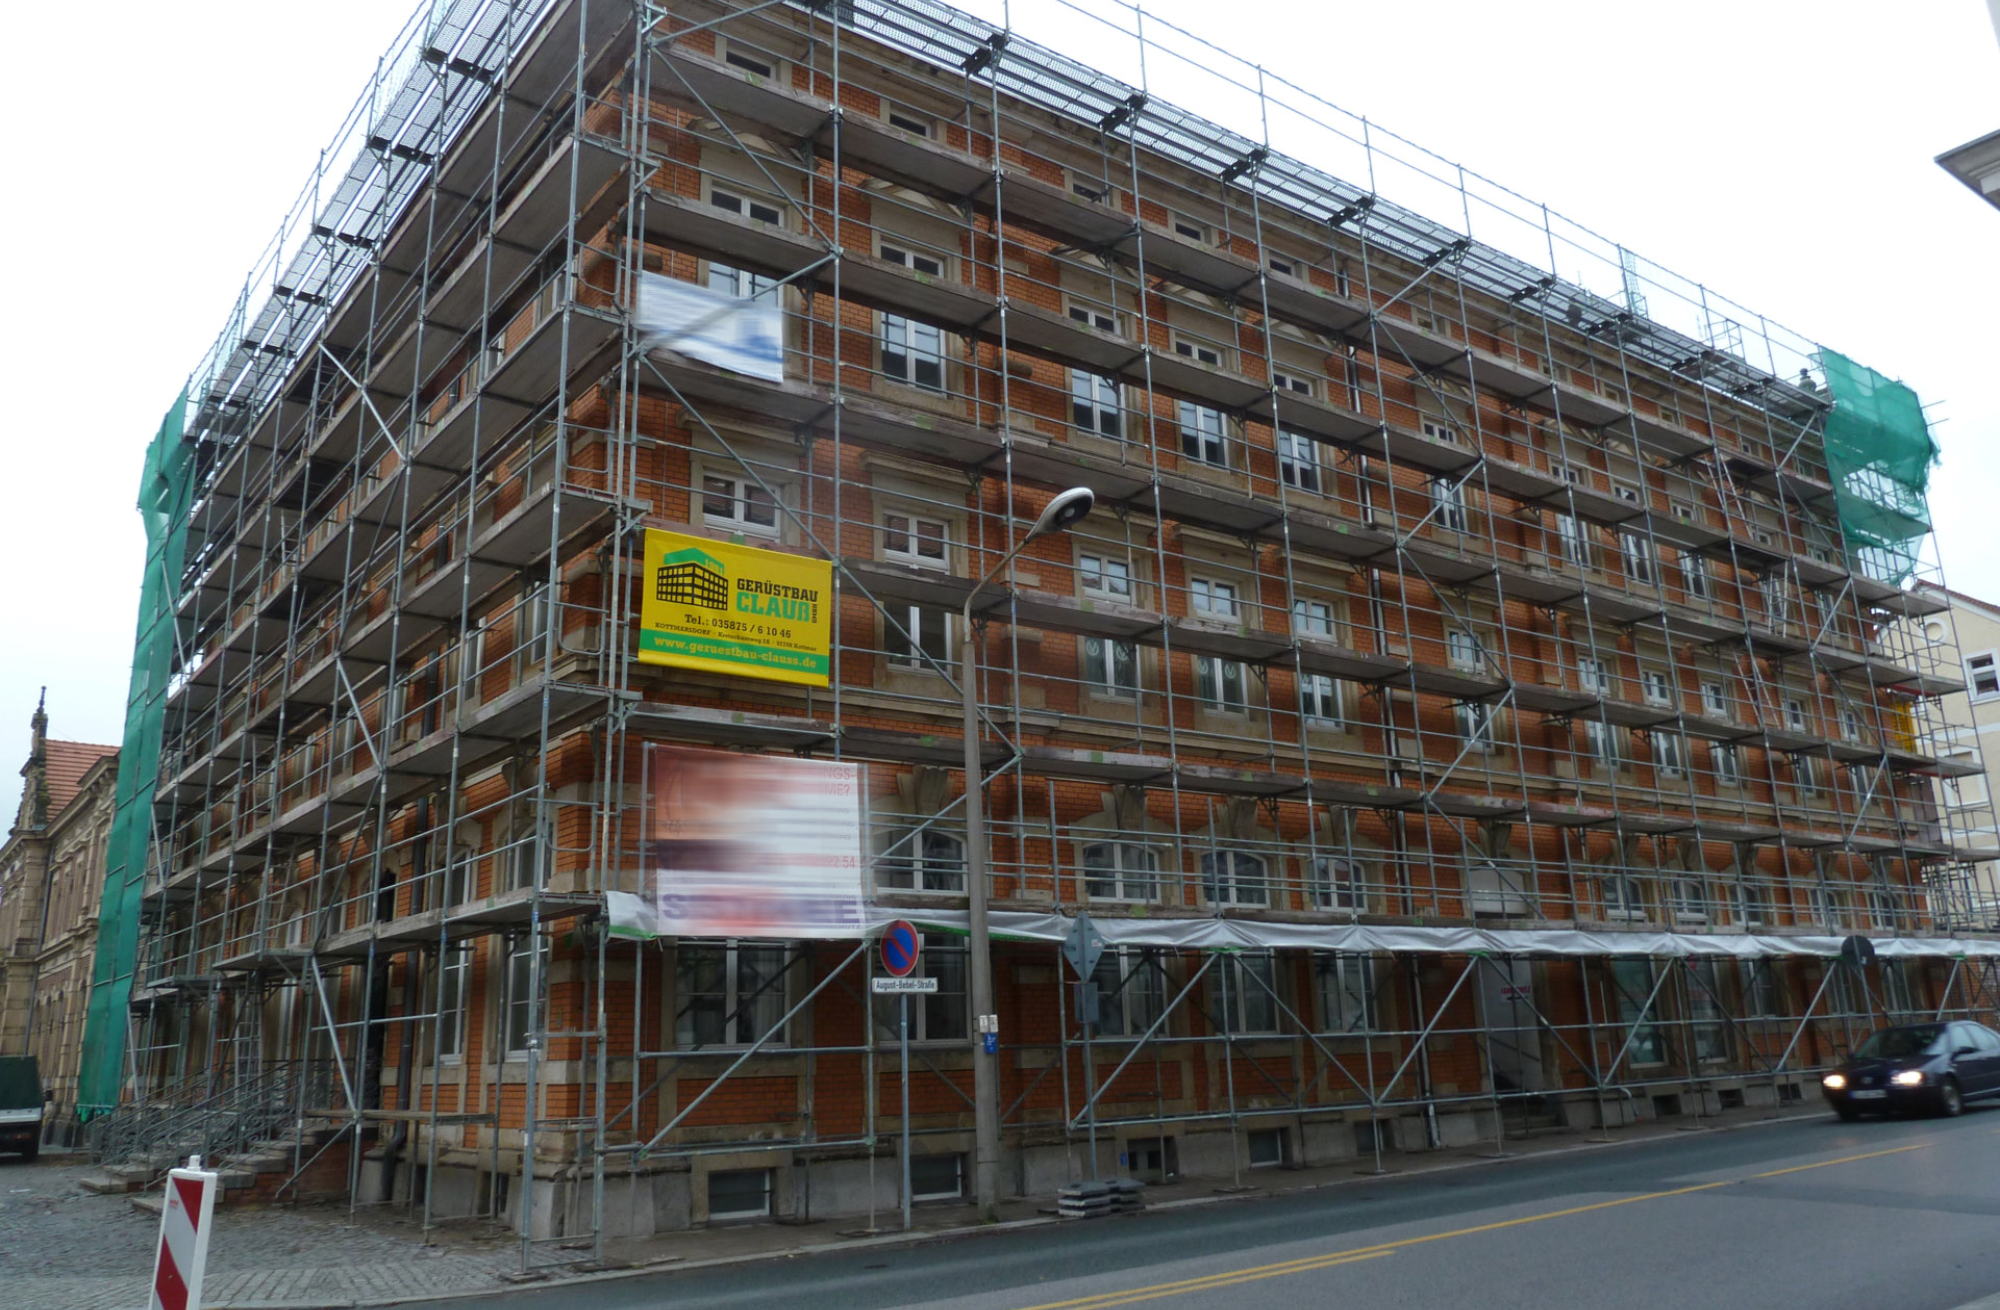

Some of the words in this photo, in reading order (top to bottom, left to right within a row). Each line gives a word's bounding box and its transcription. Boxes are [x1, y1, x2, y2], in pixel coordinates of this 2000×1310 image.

[737, 578, 818, 602] GERÜSTBAU
[655, 622, 711, 635] KOTTMARSDORF
[685, 614, 709, 626] Tel.:
[712, 618, 747, 632] 035875
[757, 626, 763, 635] 6
[766, 626, 777, 637] 10
[780, 630, 791, 639] 46
[654, 637, 817, 668] www.geruestbau-clauss.de
[876, 980, 935, 991] August-Bebel-Straße
